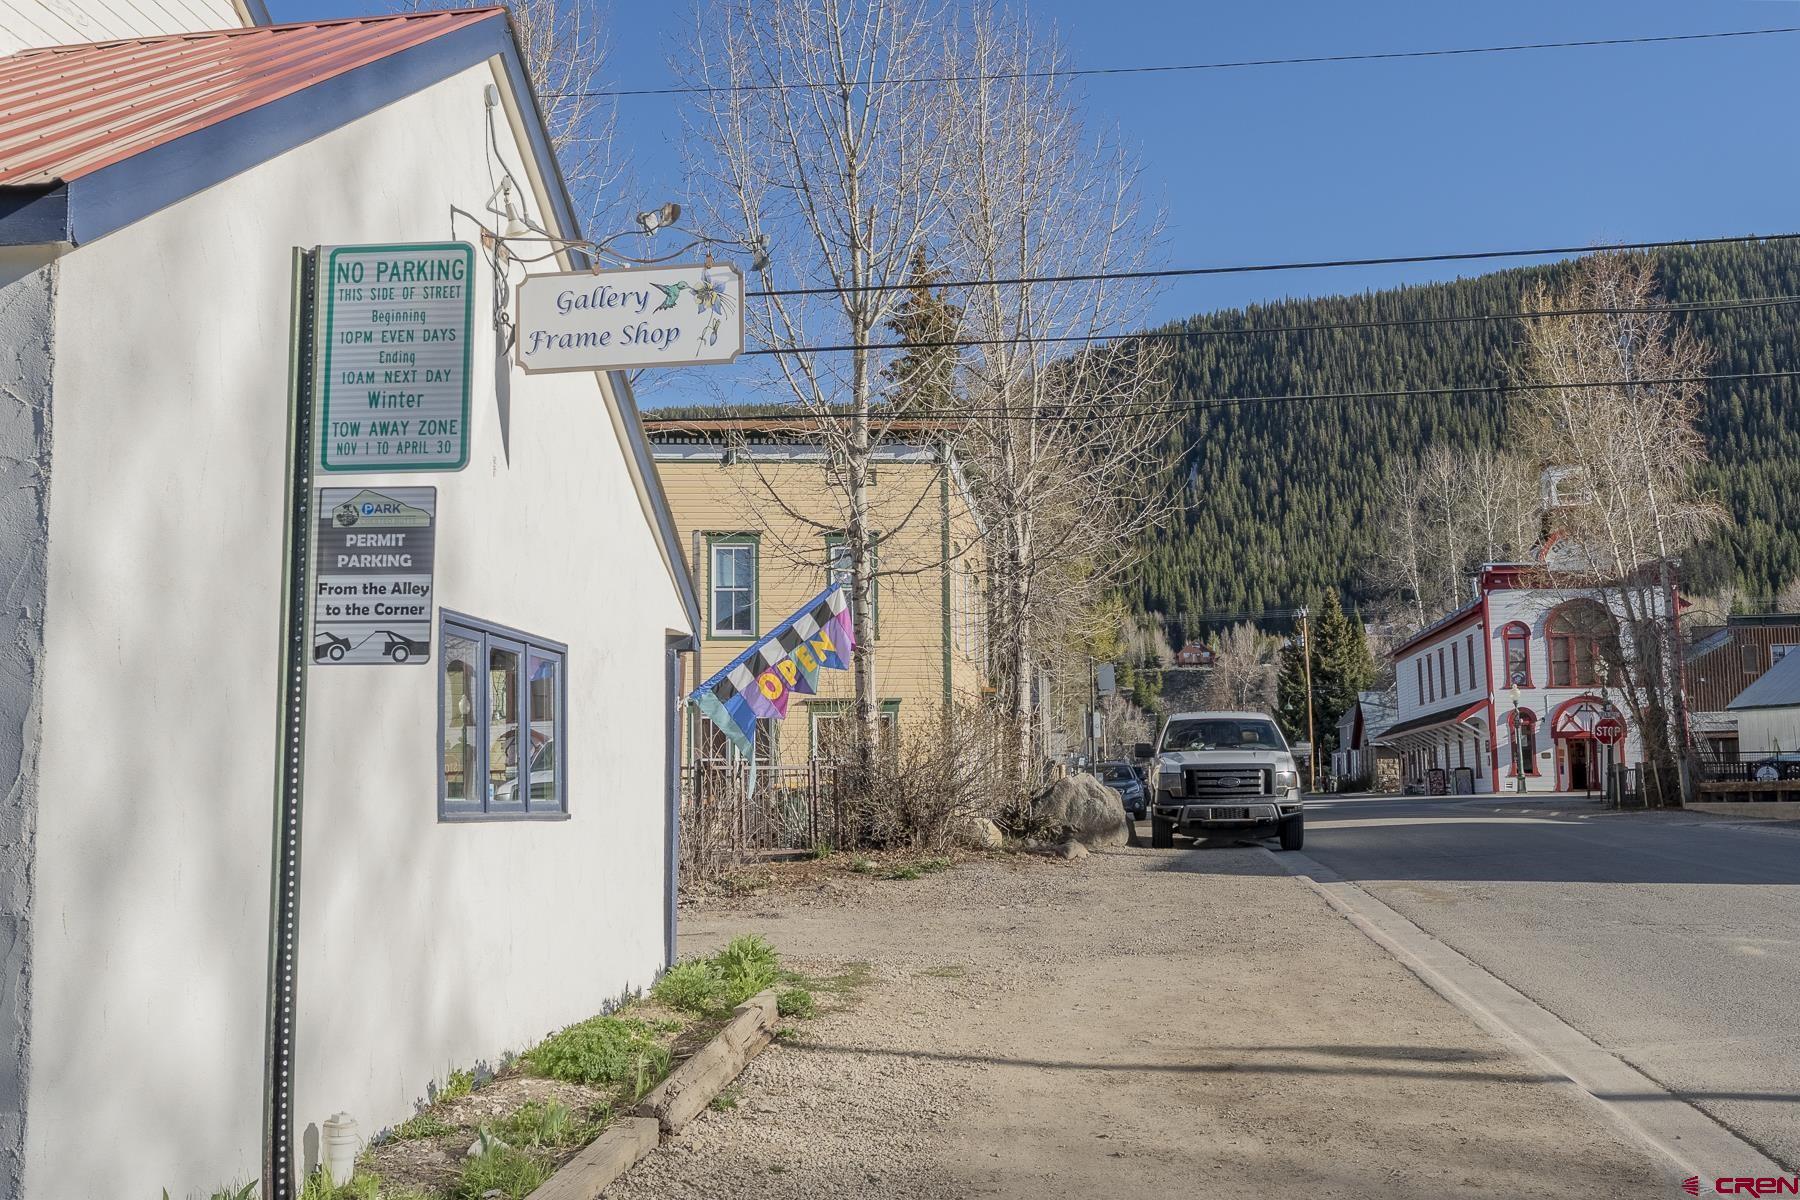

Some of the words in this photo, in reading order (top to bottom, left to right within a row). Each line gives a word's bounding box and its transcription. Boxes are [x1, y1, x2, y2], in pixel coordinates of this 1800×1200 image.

[337, 261, 364, 284] NO
[376, 258, 464, 283] PARKING
[339, 288, 363, 302] THIS
[370, 286, 395, 301] SIDE
[402, 286, 415, 300] OF
[423, 285, 461, 300] STREET
[556, 285, 649, 315] Gallery
[371, 309, 426, 326] Beginning
[340, 331, 373, 344] 10PM
[381, 329, 415, 344] EVEN
[423, 328, 456, 342] DAYS
[525, 329, 612, 355] Frame
[619, 321, 680, 351] Shop
[379, 350, 416, 367] Ending
[342, 371, 375, 385] 10AM
[384, 370, 418, 384] NEXT
[426, 369, 451, 383] DAY
[367, 390, 424, 409] Winter
[332, 421, 361, 437] TOW
[368, 420, 410, 436] AWAY
[418, 419, 458, 435] ZONE
[336, 442, 357, 456] NOV
[365, 442, 369, 455] 1
[377, 441, 389, 455] TO
[396, 440, 429, 454] APRIL
[437, 440, 451, 454] 30
[361, 502, 401, 515] PARK
[345, 533, 406, 547] PERMIT
[337, 554, 412, 567] PARKING
[318, 582, 358, 596] From
[362, 582, 387, 595] the
[390, 581, 430, 597] Alley
[325, 604, 341, 616] to
[345, 603, 370, 616] the
[374, 602, 425, 616] Corner
[758, 630, 837, 701] OPEN
[1596, 726, 1621, 737] STOP
